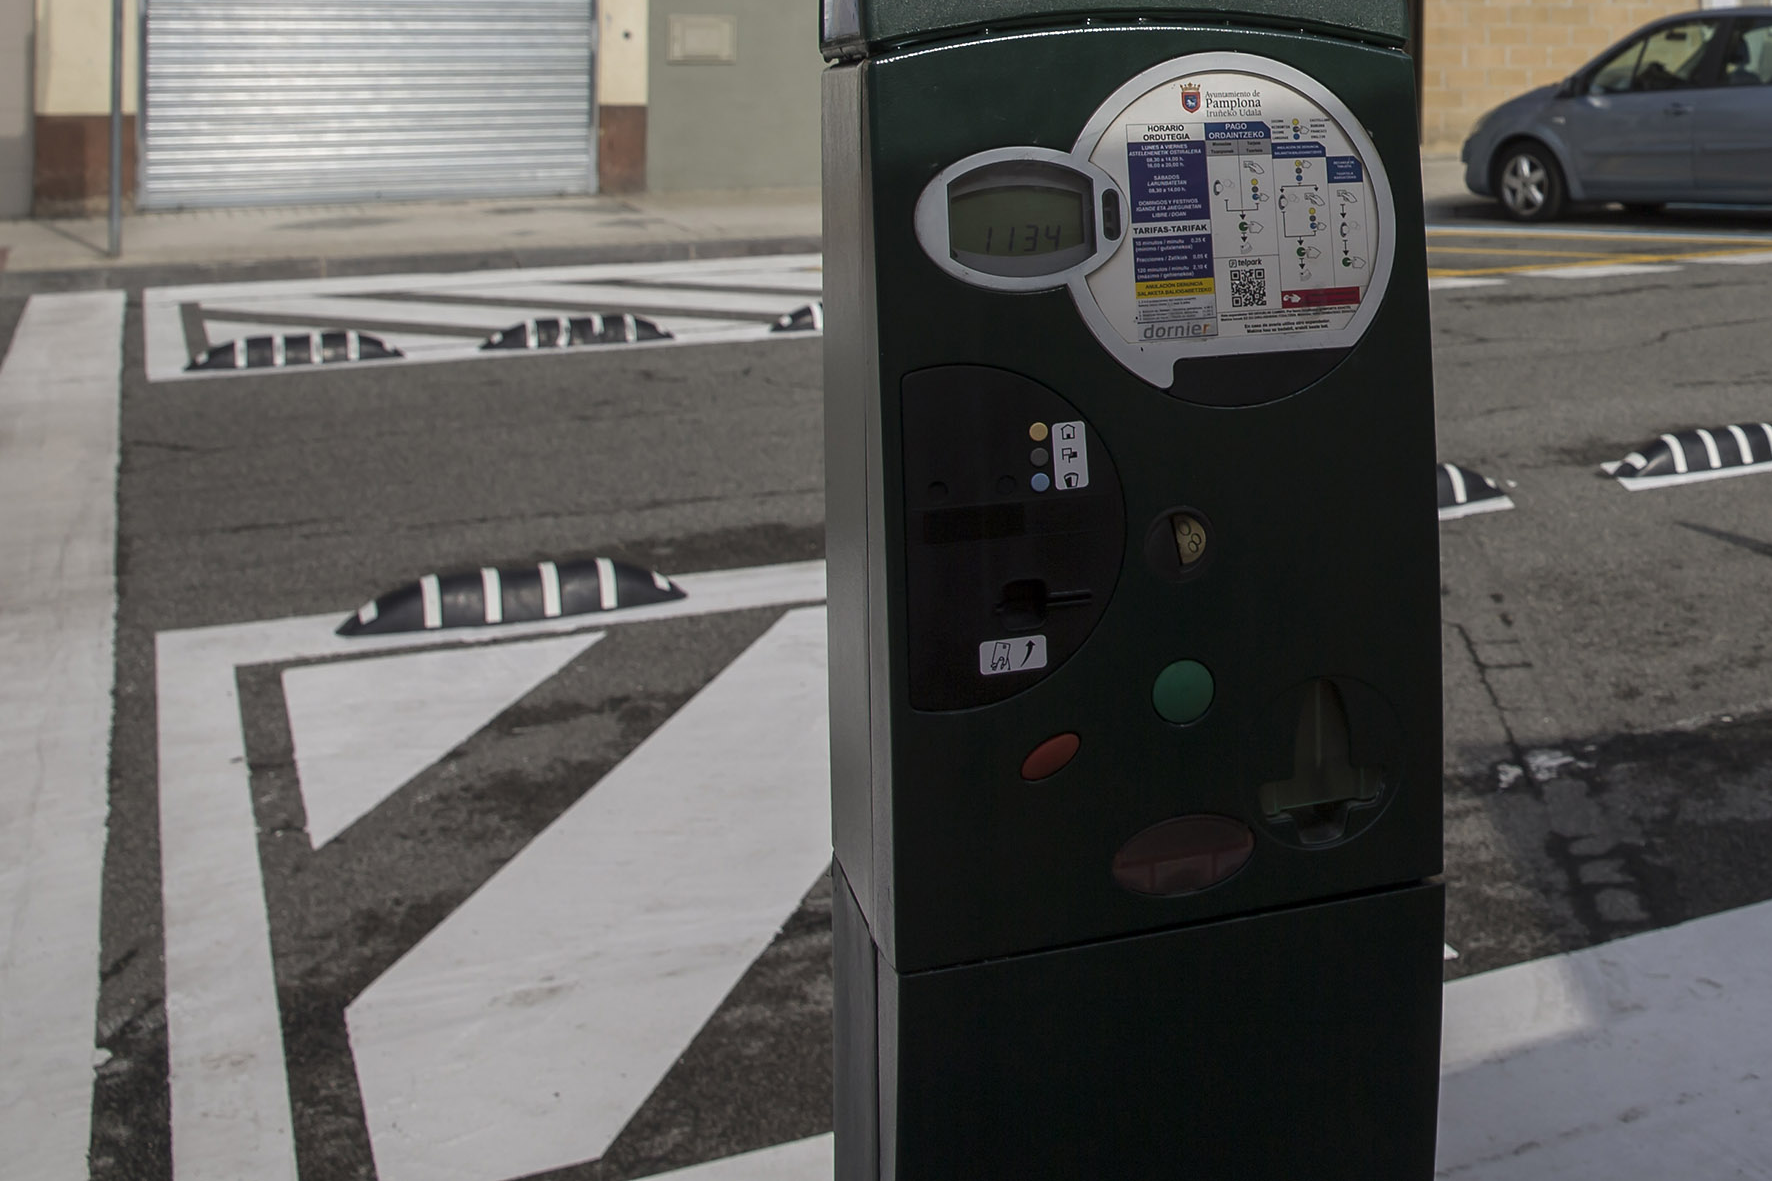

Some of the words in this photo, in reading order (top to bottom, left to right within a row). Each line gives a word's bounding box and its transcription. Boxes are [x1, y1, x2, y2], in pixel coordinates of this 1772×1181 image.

[1206, 98, 1261, 110] Pamplona
[1206, 109, 1237, 117] Iruñeko
[1143, 133, 1190, 141] ORDUTEGIA
[1208, 130, 1264, 139] ORDAINTZEKO
[1133, 224, 1207, 234] TARIFAS-TARIFAK
[1238, 258, 1262, 267] telpark
[1144, 322, 1210, 339] dornier
